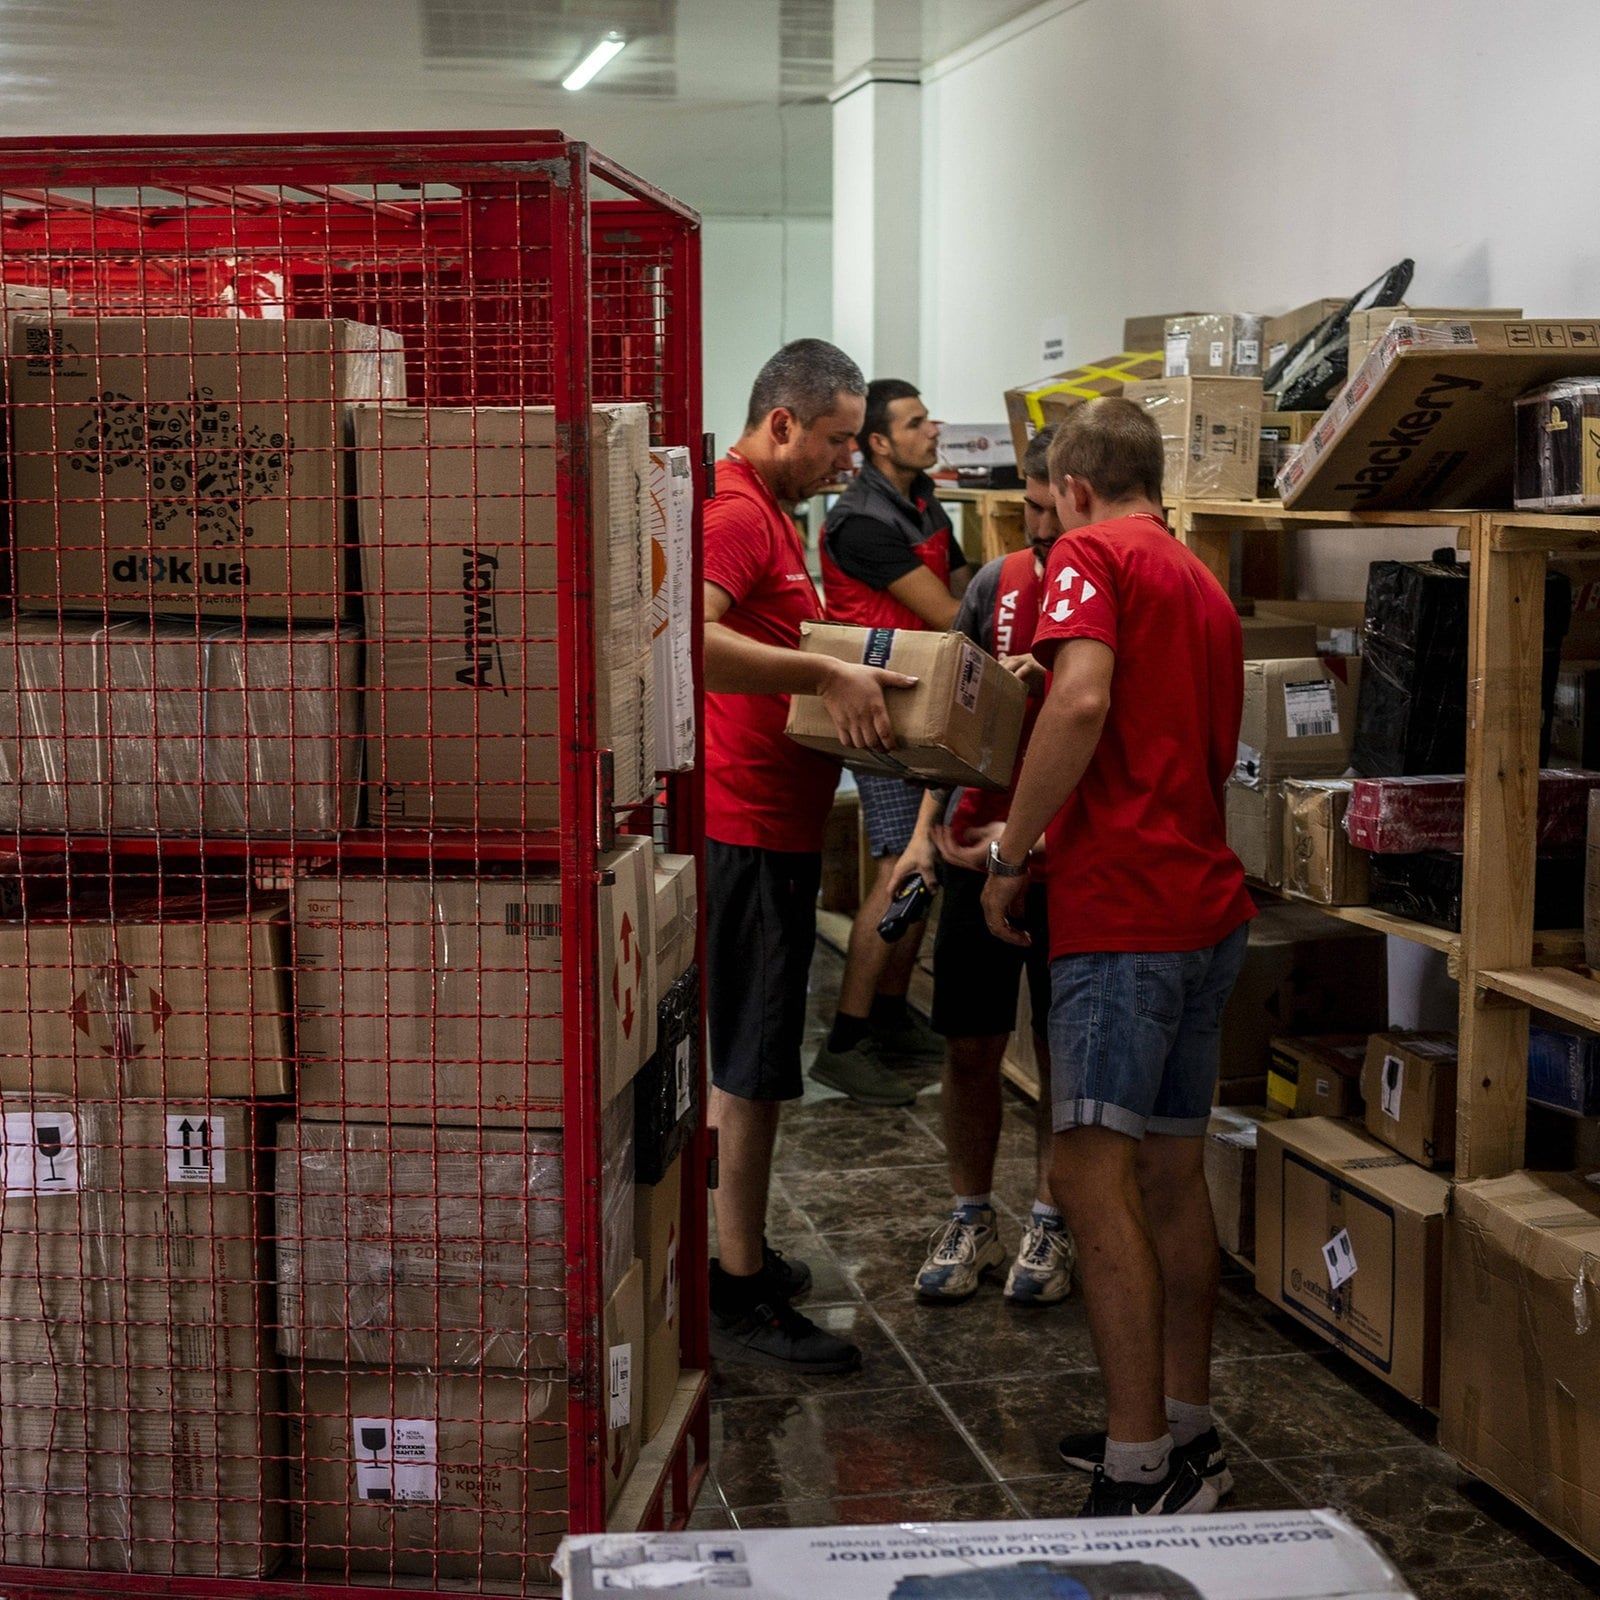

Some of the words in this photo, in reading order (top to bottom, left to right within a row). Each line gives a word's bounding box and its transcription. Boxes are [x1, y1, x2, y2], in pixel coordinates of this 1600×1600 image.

[1334, 372, 1484, 501] Jackery
[112, 555, 251, 585] dok.ua
[456, 548, 499, 693] Amway
[995, 589, 1020, 660] ШТА
[307, 903, 319, 912] 10
[1094, 1525, 1185, 1539] generator
[1191, 1521, 1248, 1534] power
[1207, 1527, 1334, 1548] SG2500i
[825, 1537, 1200, 1563] Inverter-Stromgenerator
